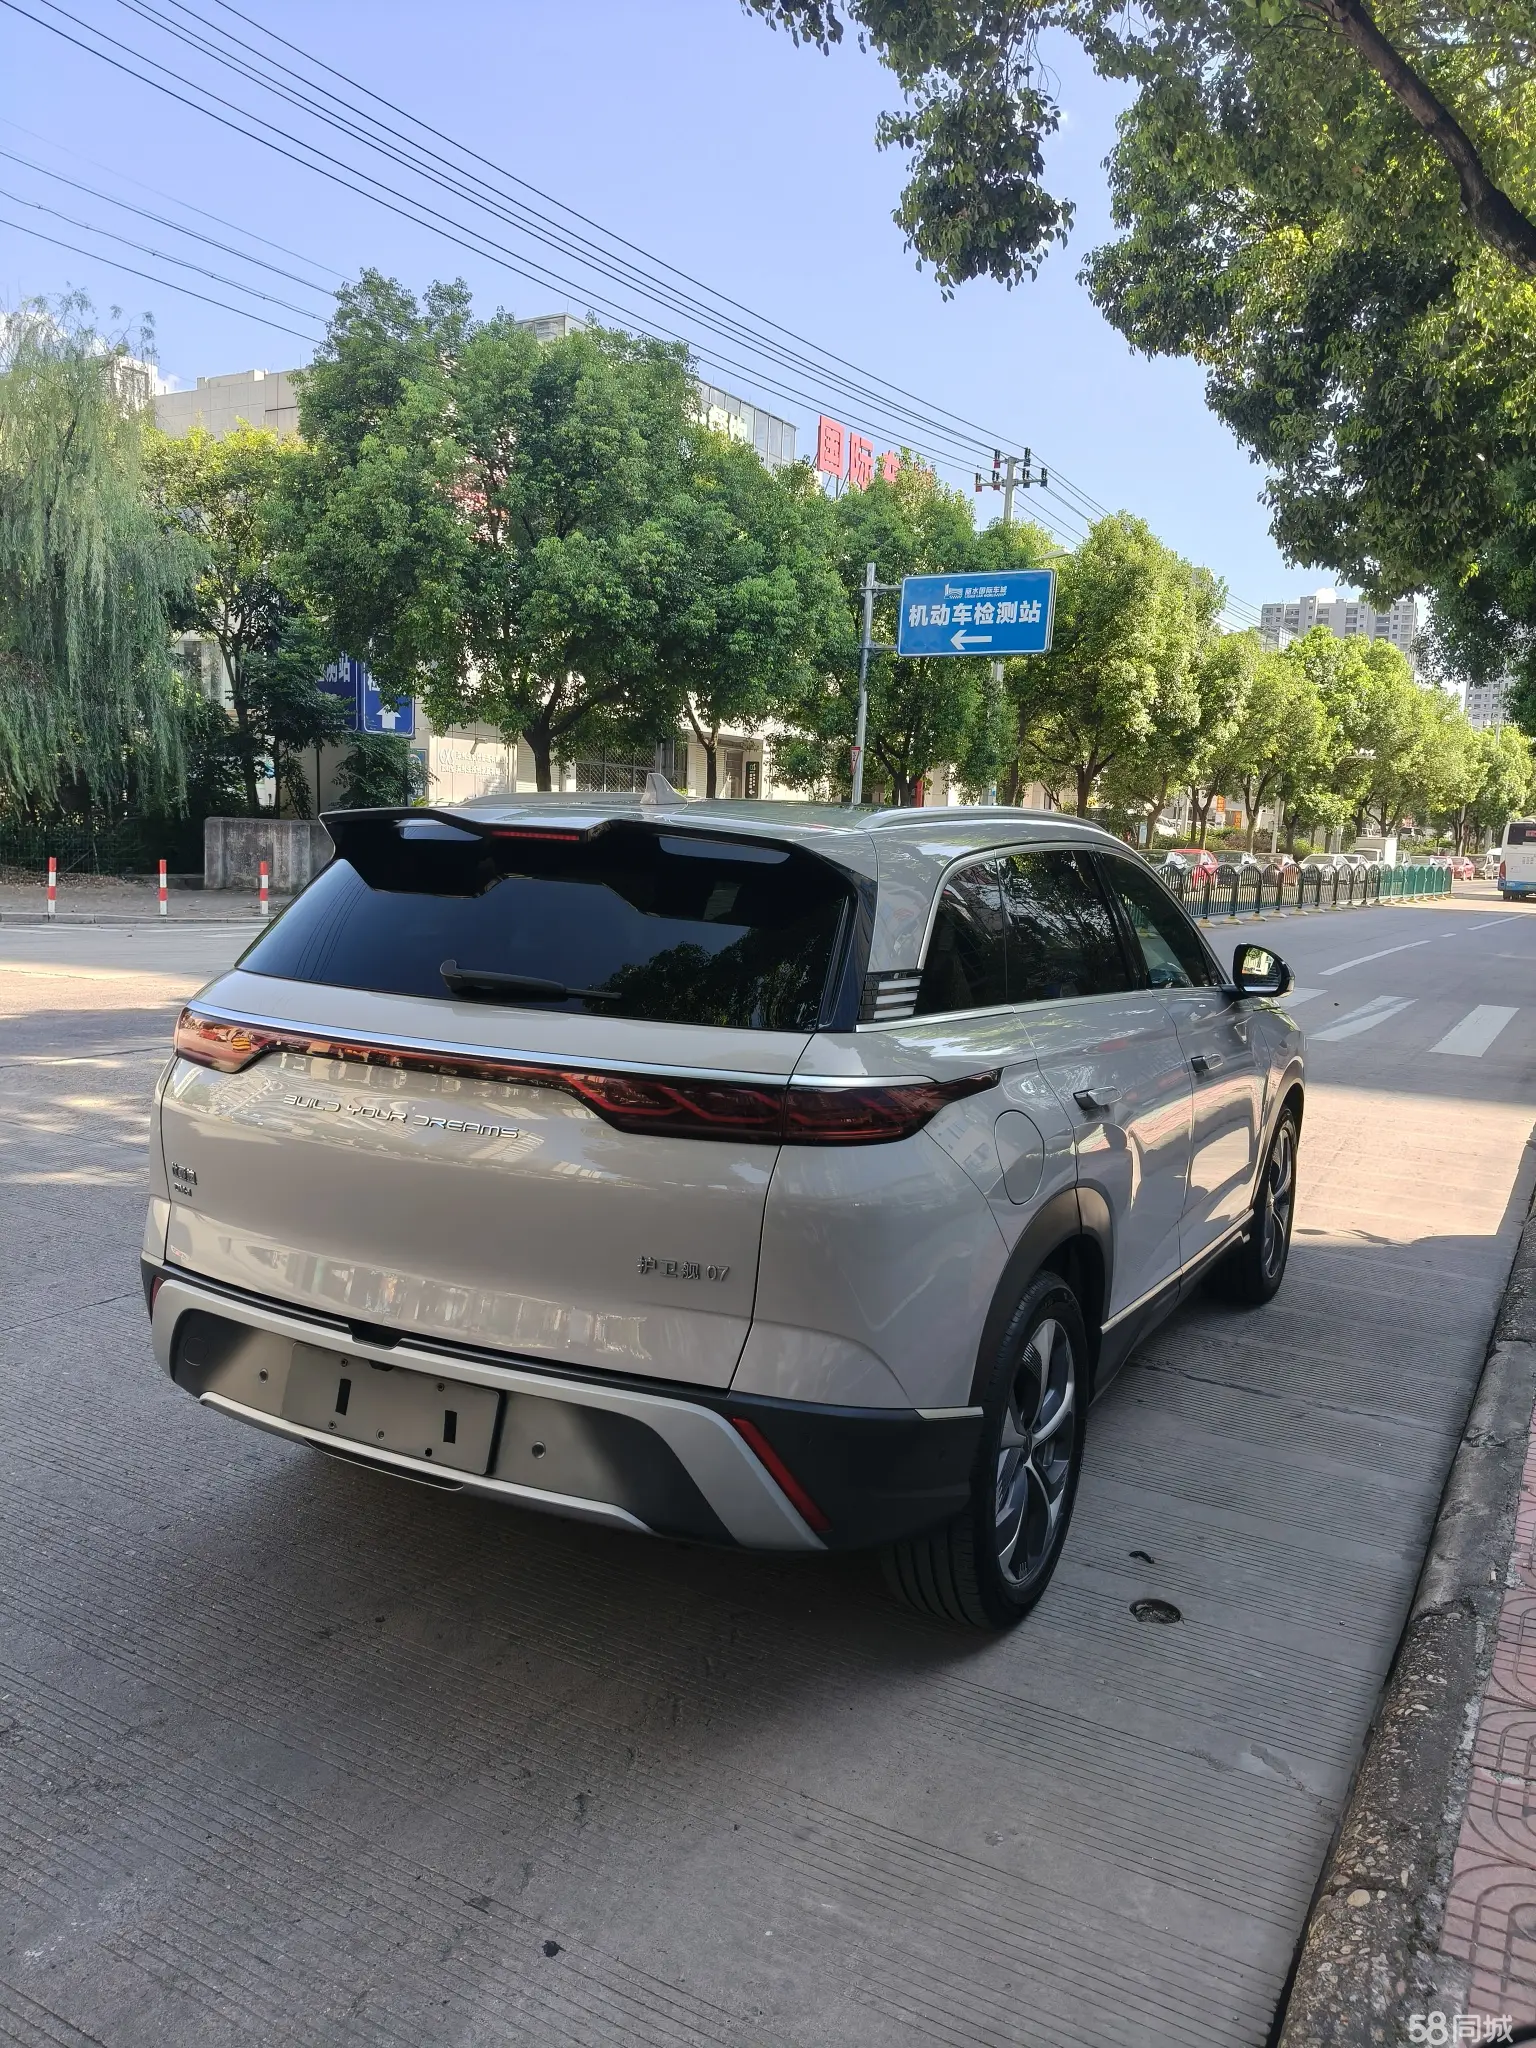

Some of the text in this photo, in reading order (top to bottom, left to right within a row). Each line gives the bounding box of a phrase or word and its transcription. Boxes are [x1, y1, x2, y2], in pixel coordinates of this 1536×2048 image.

[909, 600, 1041, 627] 机动车检测站
[283, 1094, 519, 1139] BUILD YOUR DREAMS
[637, 1256, 730, 1282] 护卫舰 07
